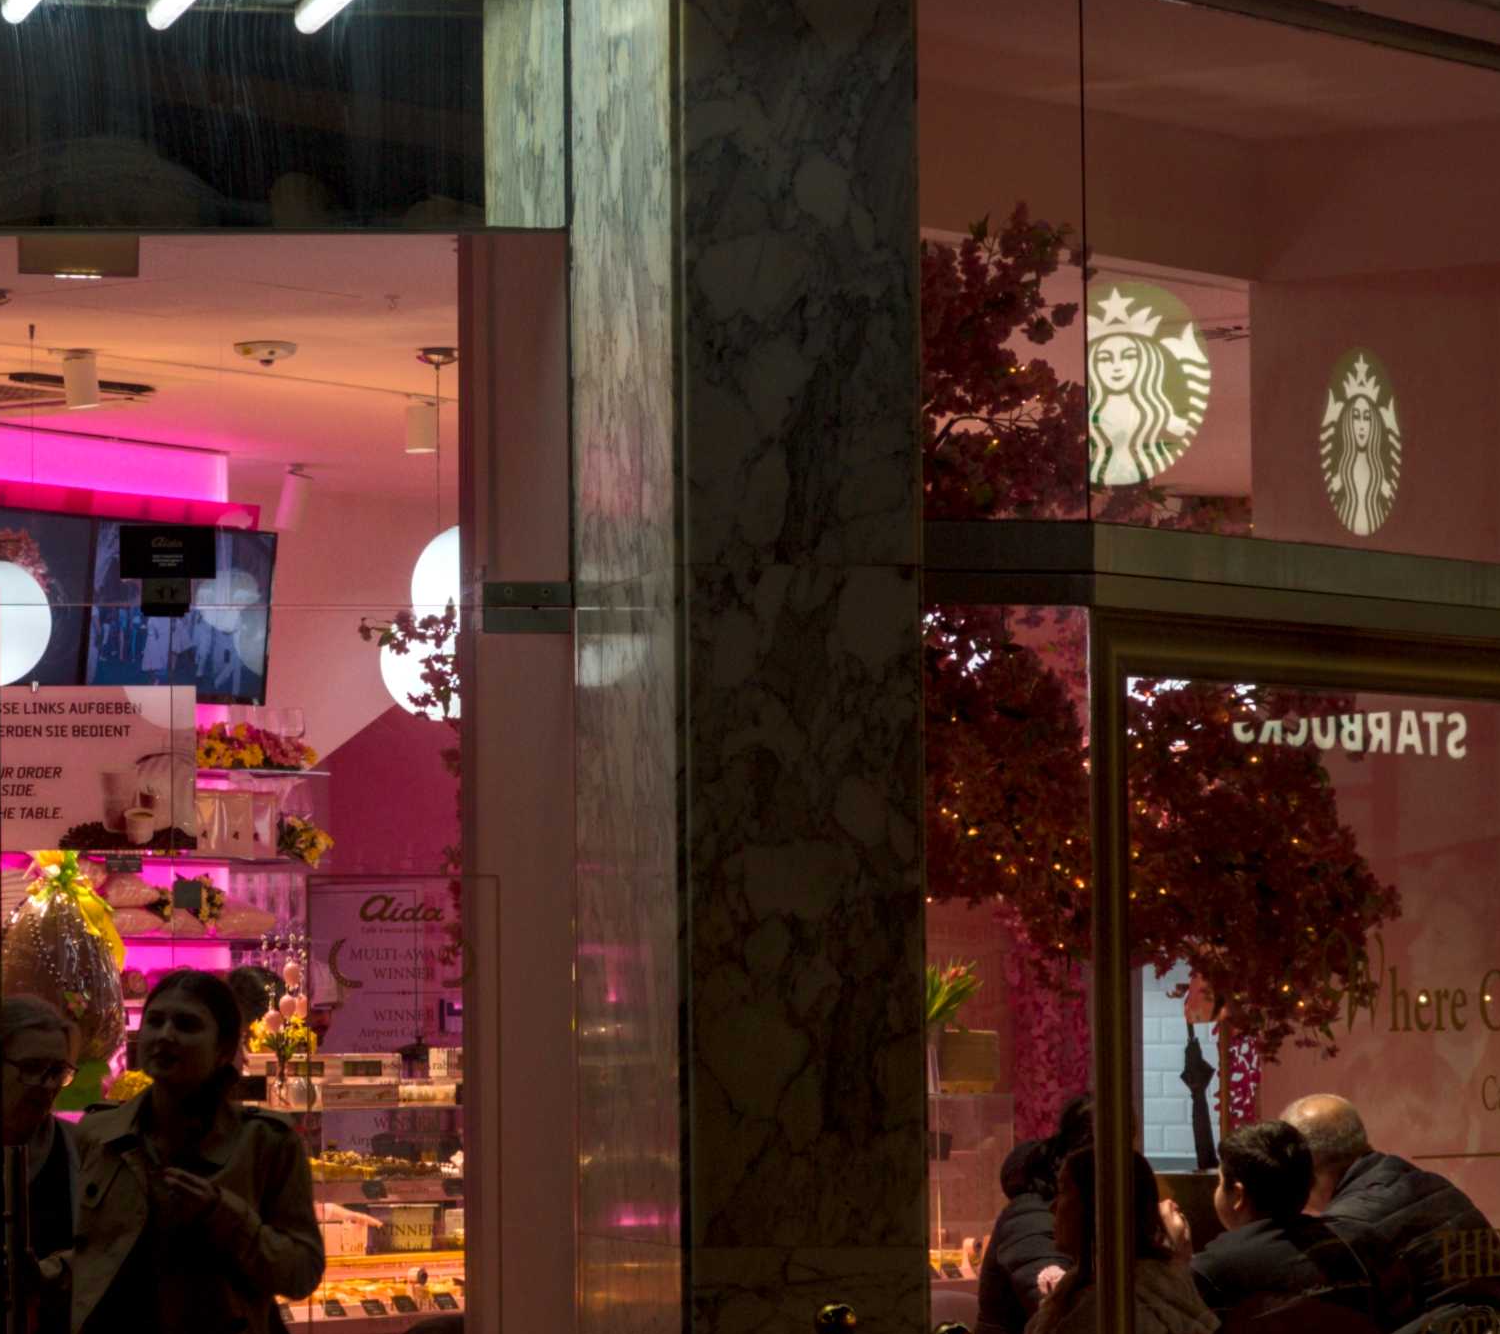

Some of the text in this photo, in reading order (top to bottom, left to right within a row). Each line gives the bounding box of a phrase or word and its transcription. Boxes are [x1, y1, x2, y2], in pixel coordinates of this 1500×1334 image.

[23, 702, 66, 715] LINKS
[46, 725, 69, 738] SIE
[72, 725, 132, 738] BEDIENT
[16, 767, 63, 779] ORDER
[373, 967, 434, 981] WINNER
[373, 1009, 434, 1022] WINNER
